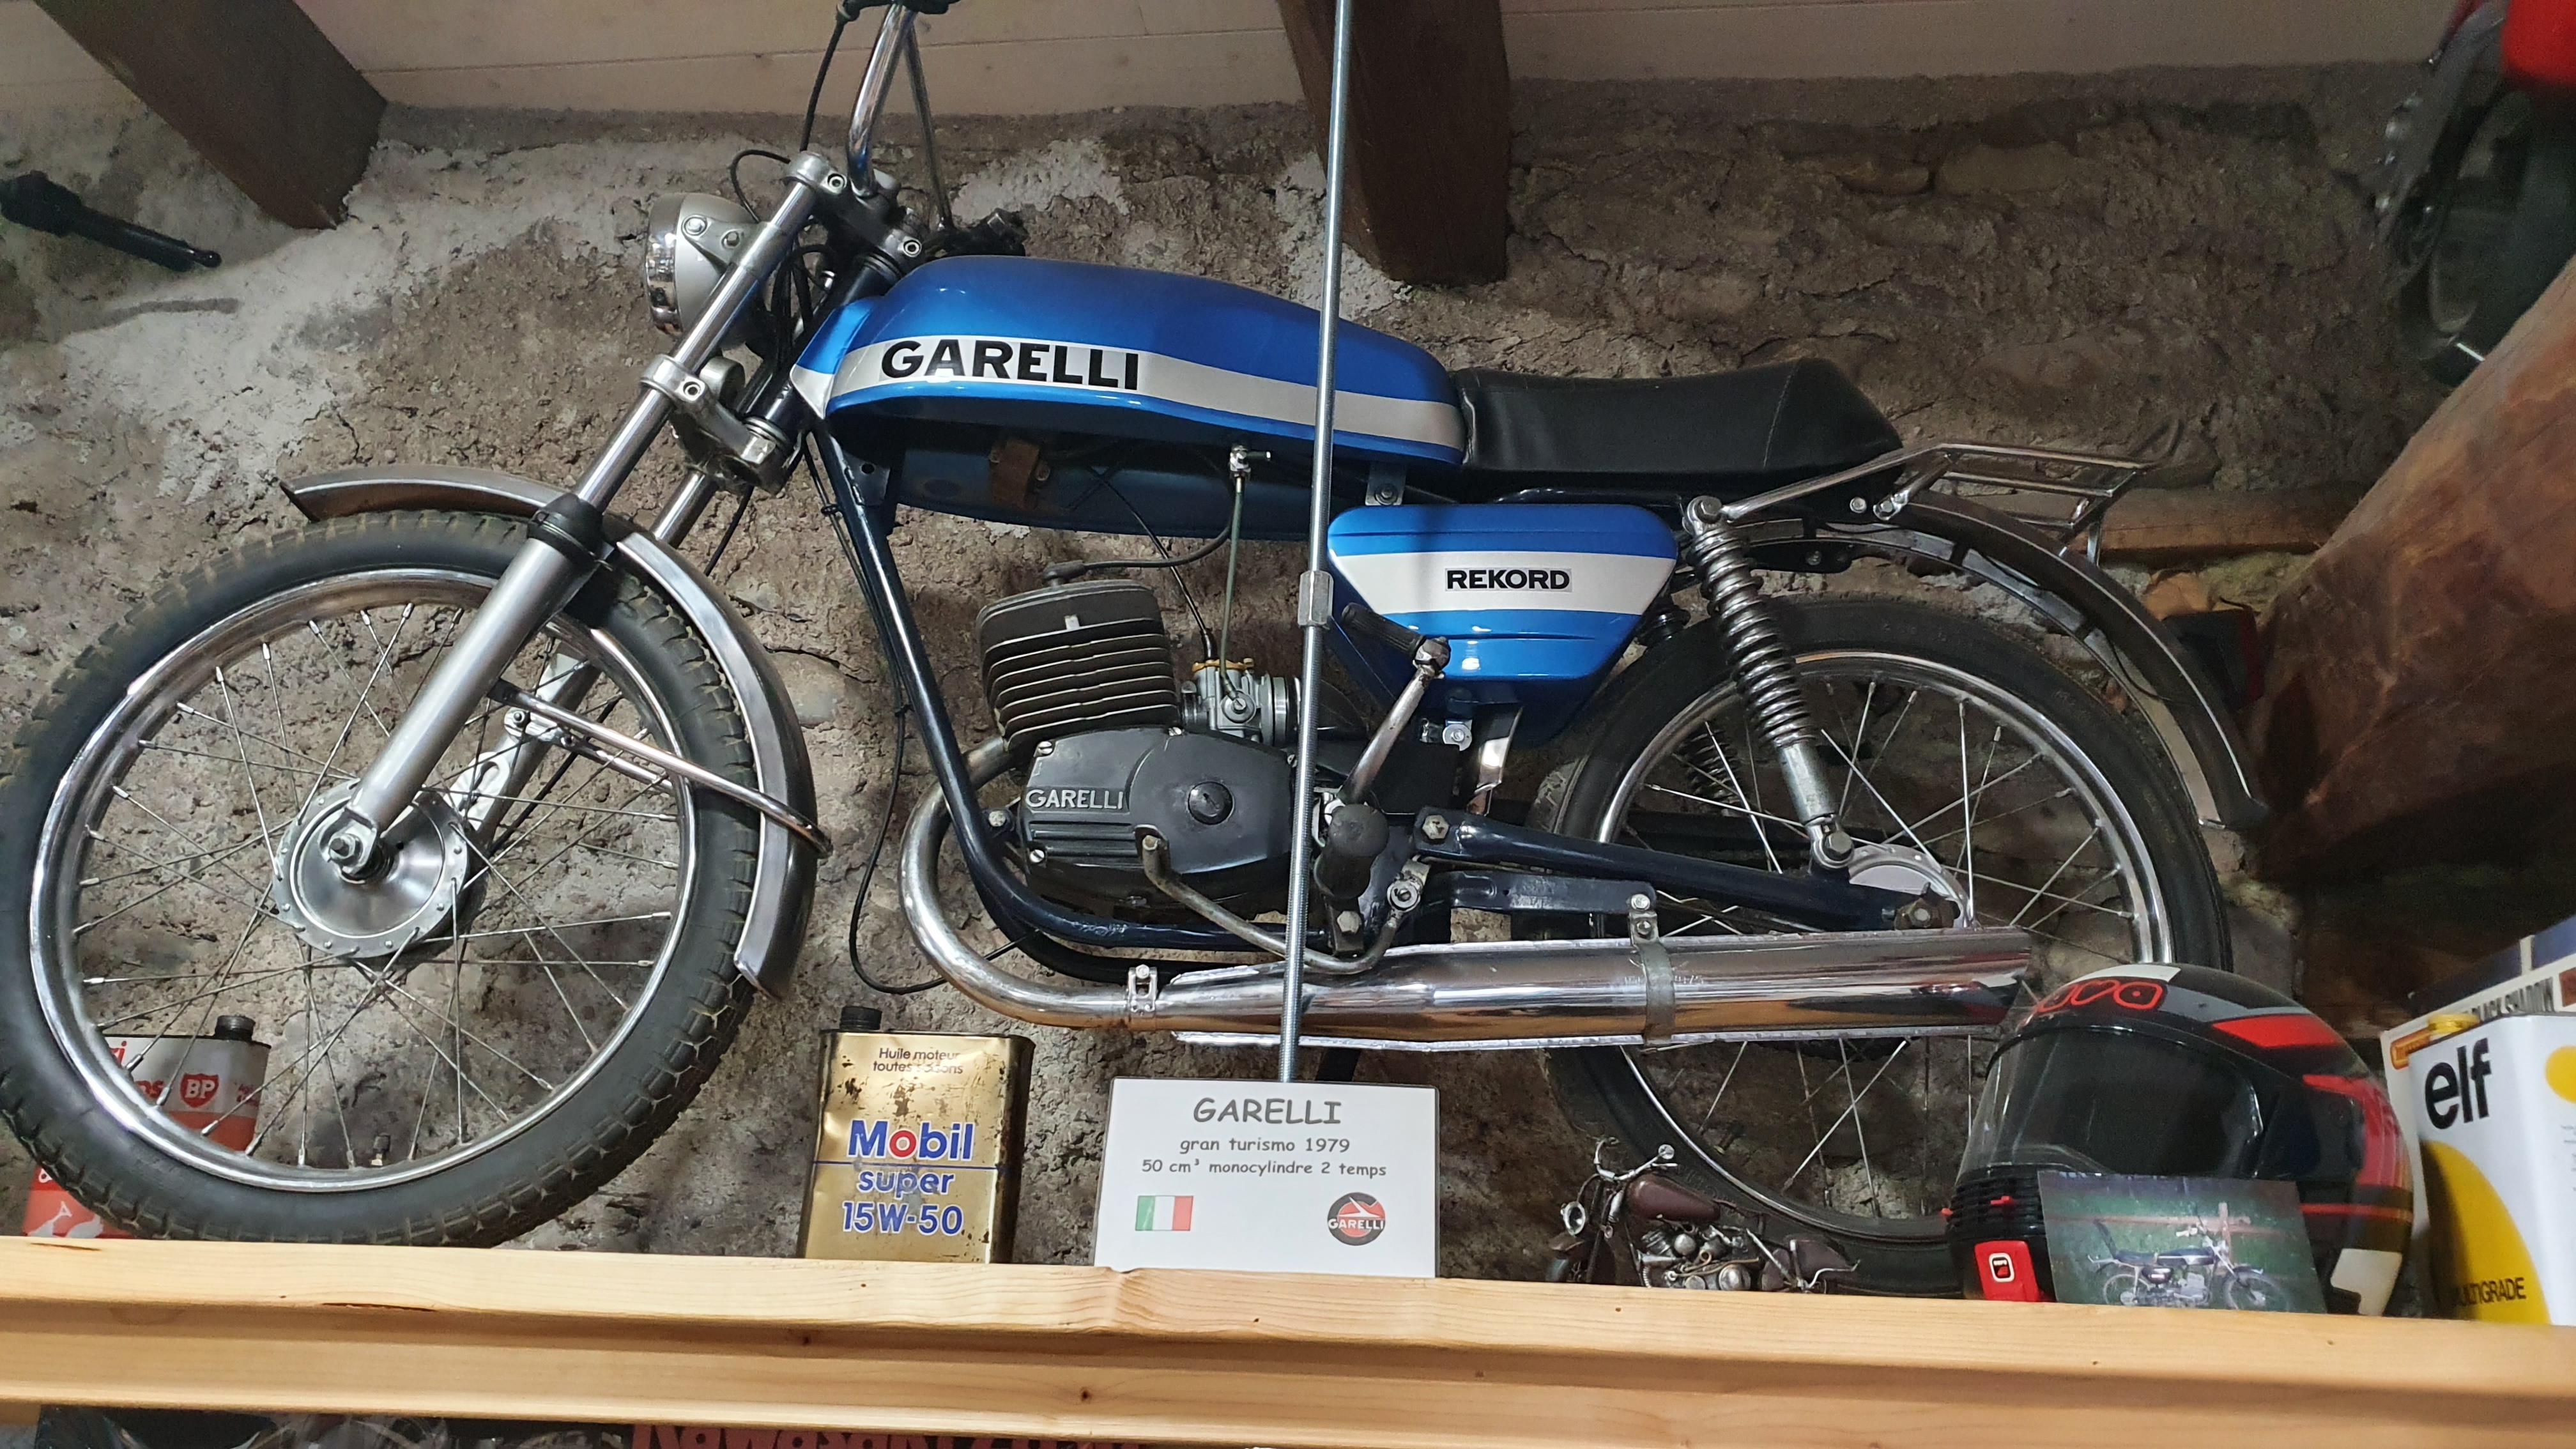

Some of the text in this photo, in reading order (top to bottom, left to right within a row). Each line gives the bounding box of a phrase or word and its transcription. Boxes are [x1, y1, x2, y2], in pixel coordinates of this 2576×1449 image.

[881, 339, 1139, 391] GARELLI
[1446, 569, 1570, 590] REKORD
[1025, 788, 1124, 809] GARELLI
[878, 1047, 961, 1061] Huile moteur
[873, 1060, 913, 1072] toutes
[185, 1078, 215, 1099] BP
[2425, 1036, 2493, 1130] elf
[1193, 1097, 1342, 1124] GARELLI
[847, 1119, 976, 1162] Mobil
[1179, 1137, 1351, 1154] gran turismo 1979
[1141, 1159, 1163, 1173] 50
[1208, 1160, 1313, 1177] monocylindre
[1320, 1162, 1331, 1174] 2
[1338, 1163, 1387, 1179] temps
[857, 1169, 955, 1199] super
[842, 1200, 964, 1236] 15W-50
[1327, 1217, 1386, 1230] GARELLI
[2453, 1276, 2527, 1308] ULTIGRADE
